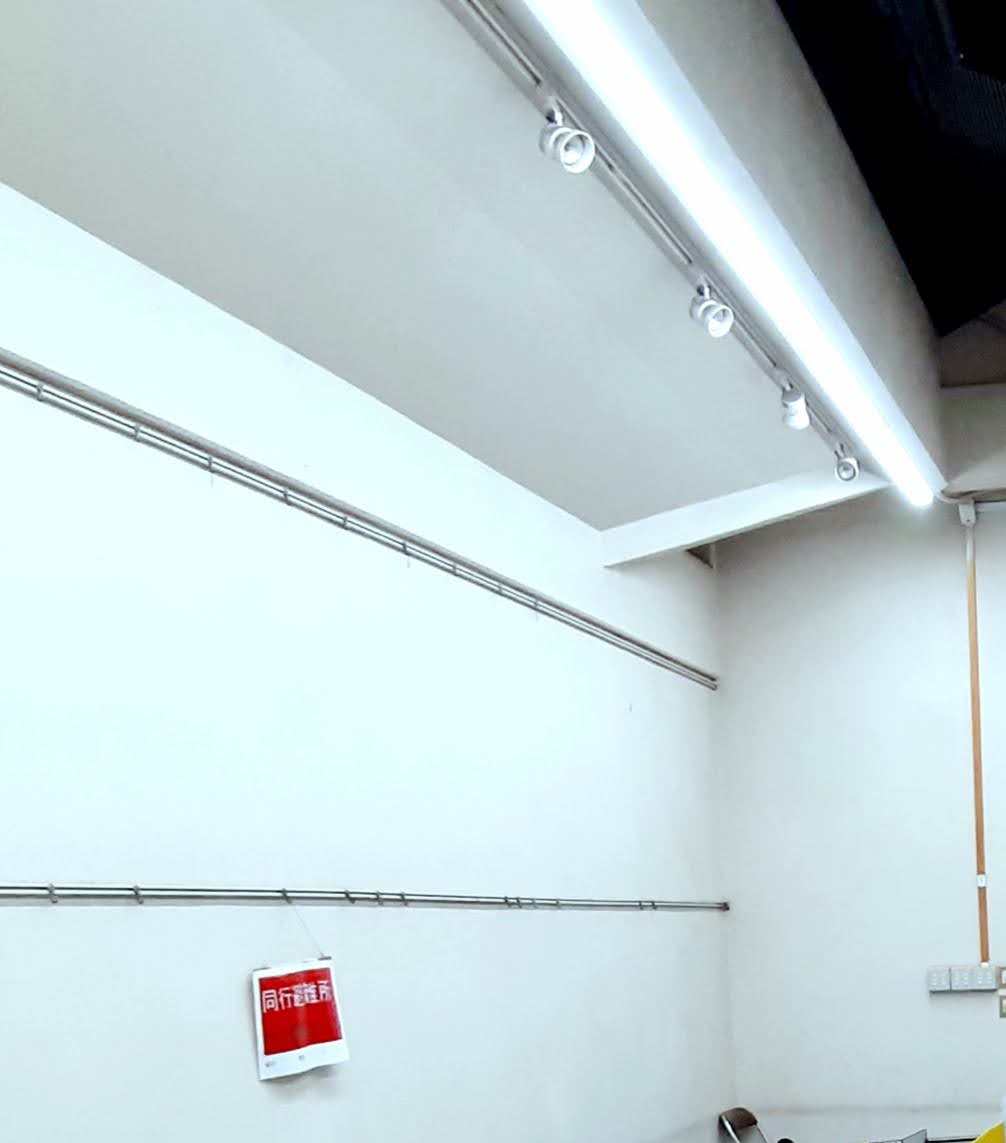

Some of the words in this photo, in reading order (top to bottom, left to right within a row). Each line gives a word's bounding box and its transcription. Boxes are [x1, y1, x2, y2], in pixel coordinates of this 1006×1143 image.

[261, 979, 332, 1013] 同行避難所
